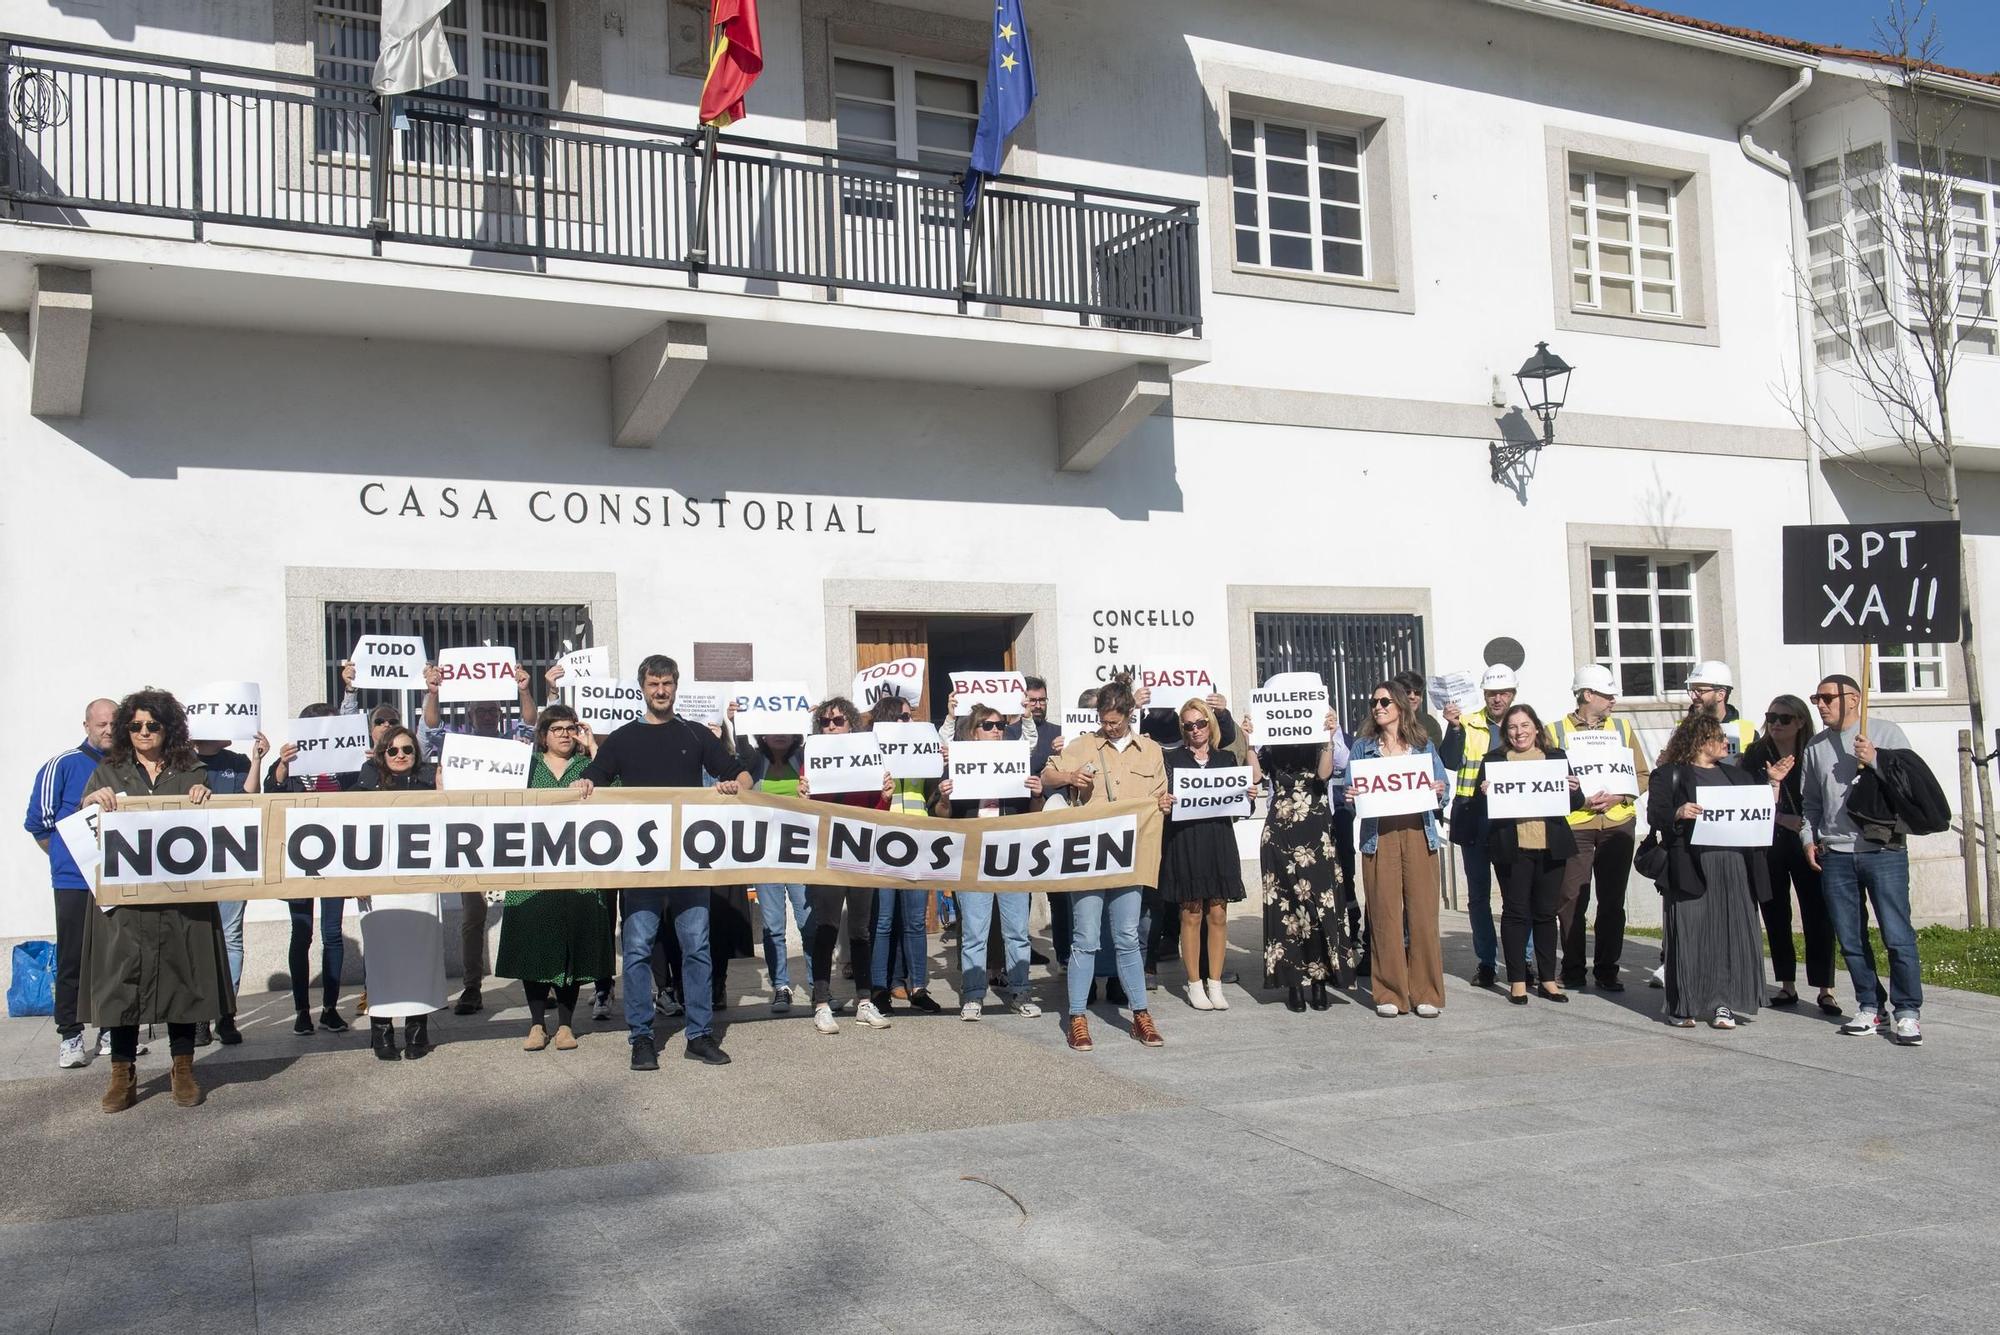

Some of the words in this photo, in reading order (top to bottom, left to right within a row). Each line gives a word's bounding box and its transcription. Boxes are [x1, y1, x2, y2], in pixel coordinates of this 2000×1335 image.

[360, 483, 498, 520] CASA
[529, 491, 876, 534] CONSISTORIAL
[1827, 531, 1917, 571] RPT
[1093, 610, 1195, 627] CONCELLO
[365, 643, 416, 656] TODO
[1094, 636, 1119, 654] DE
[570, 655, 592, 665] RPT
[371, 665, 409, 678] MAL
[440, 662, 515, 680] BASTA
[574, 669, 591, 678] XA
[861, 662, 917, 681] TODO
[1142, 670, 1212, 688] BASTA
[581, 685, 643, 701] SOLDOS
[954, 679, 1026, 695] BASTA
[736, 695, 809, 713] BASTA
[1252, 690, 1326, 704] MULLERES
[186, 703, 220, 716] RPT
[224, 704, 258, 716] XA!!
[581, 708, 643, 722] DIGNOS
[1266, 708, 1313, 720] SOLDO
[1267, 726, 1313, 738] DIGNO
[297, 738, 330, 752] RPT
[334, 735, 366, 749] XA!!
[879, 743, 908, 756] RPT
[912, 742, 940, 755] XA!!
[446, 756, 484, 771] RPT
[488, 759, 525, 776] XA!!
[810, 756, 844, 770] RPT
[849, 754, 883, 768] XA!!
[954, 762, 988, 775] RPT
[993, 761, 1026, 774] XA!!
[1572, 763, 1604, 777] RPT
[1608, 762, 1635, 776] XA!!
[1179, 776, 1248, 790] SOLDOS
[1353, 772, 1432, 795] BASTA
[1493, 782, 1527, 795] RPT
[1531, 781, 1564, 793] XA!!
[1180, 794, 1244, 809] DIGNOS
[1702, 808, 1735, 822] RPT
[1740, 807, 1771, 821] XA!!
[104, 825, 259, 878] NON
[287, 819, 659, 877] QUEREMOS
[682, 820, 811, 870] QUE
[829, 823, 954, 871] NOS
[983, 829, 1135, 878] USEN
